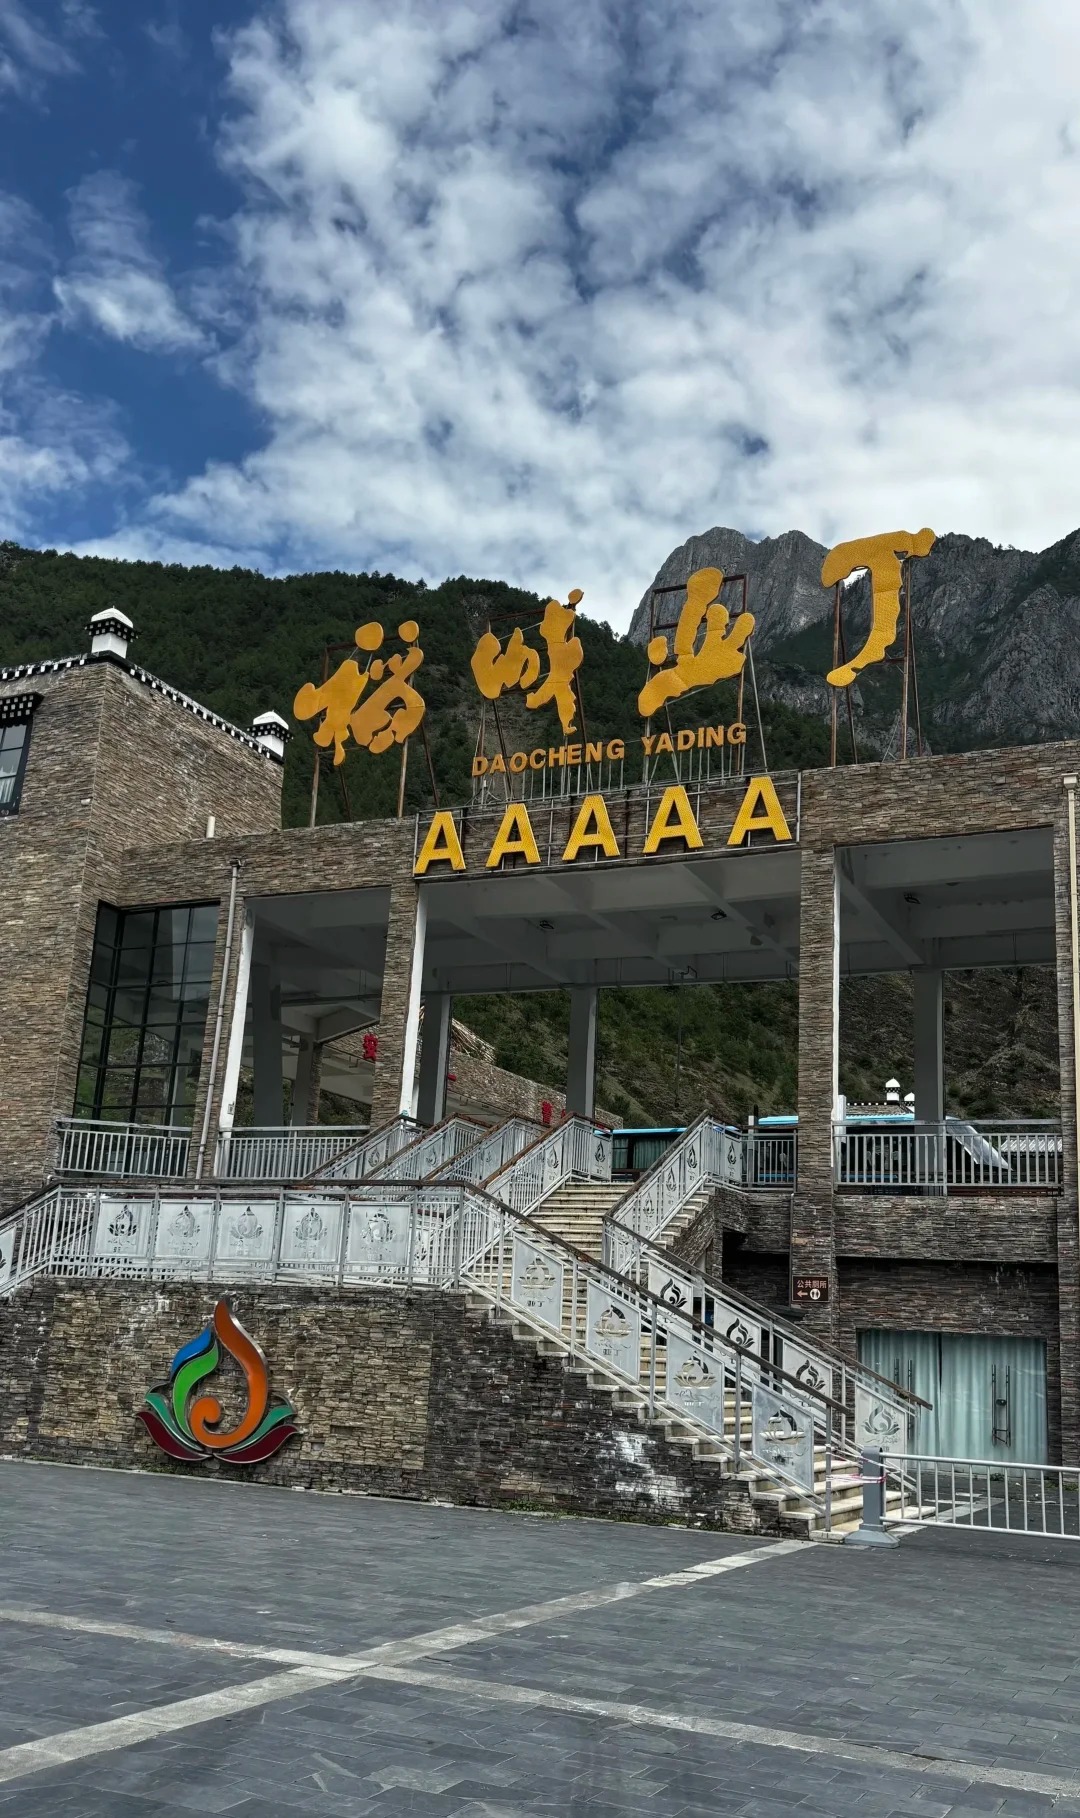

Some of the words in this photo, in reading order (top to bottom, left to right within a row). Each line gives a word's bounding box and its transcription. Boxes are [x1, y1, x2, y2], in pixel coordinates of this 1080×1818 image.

[471, 738, 625, 776] DAOCHENG
[641, 722, 747, 756] YADING
[796, 1280, 828, 1289] 公共厕所
